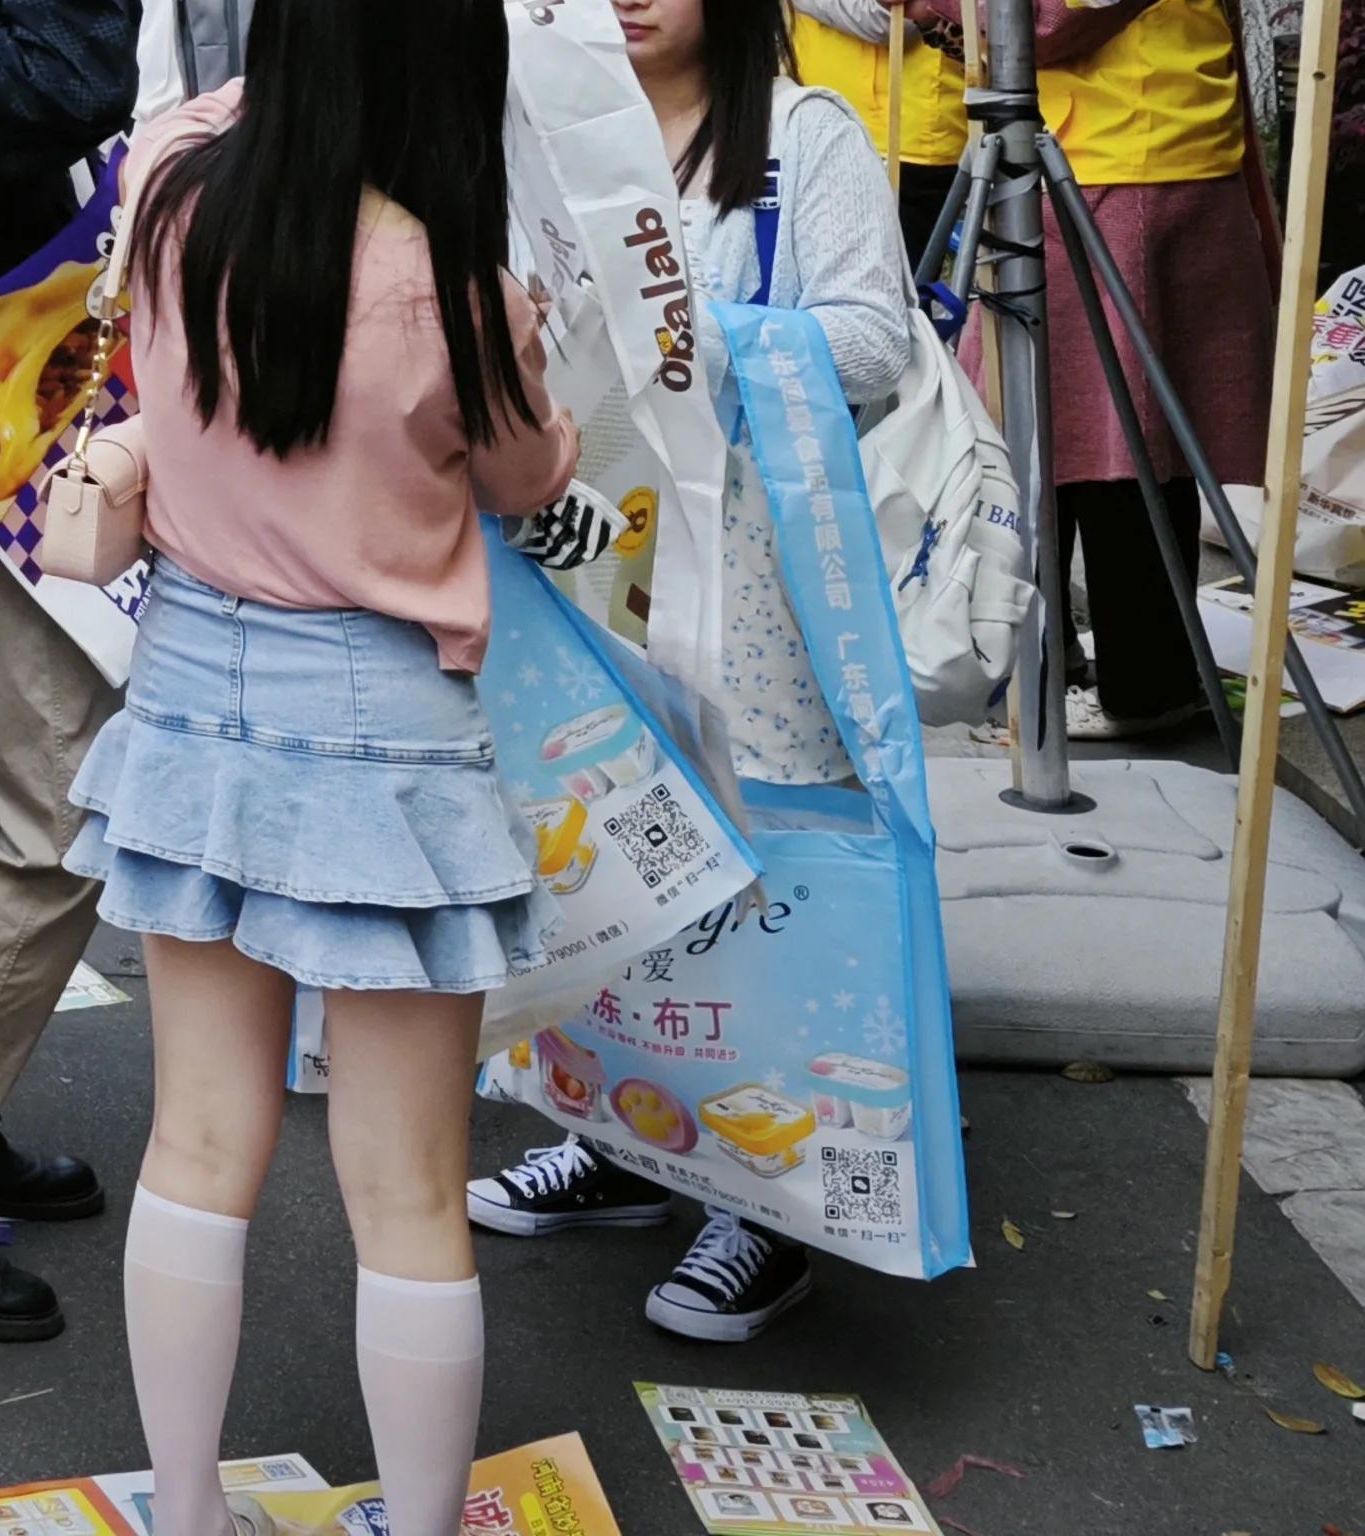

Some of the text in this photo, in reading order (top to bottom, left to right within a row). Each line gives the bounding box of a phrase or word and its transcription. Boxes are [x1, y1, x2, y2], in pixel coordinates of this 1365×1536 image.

[620, 949, 675, 983] 爱
[585, 986, 735, 1043] 冻·布丁
